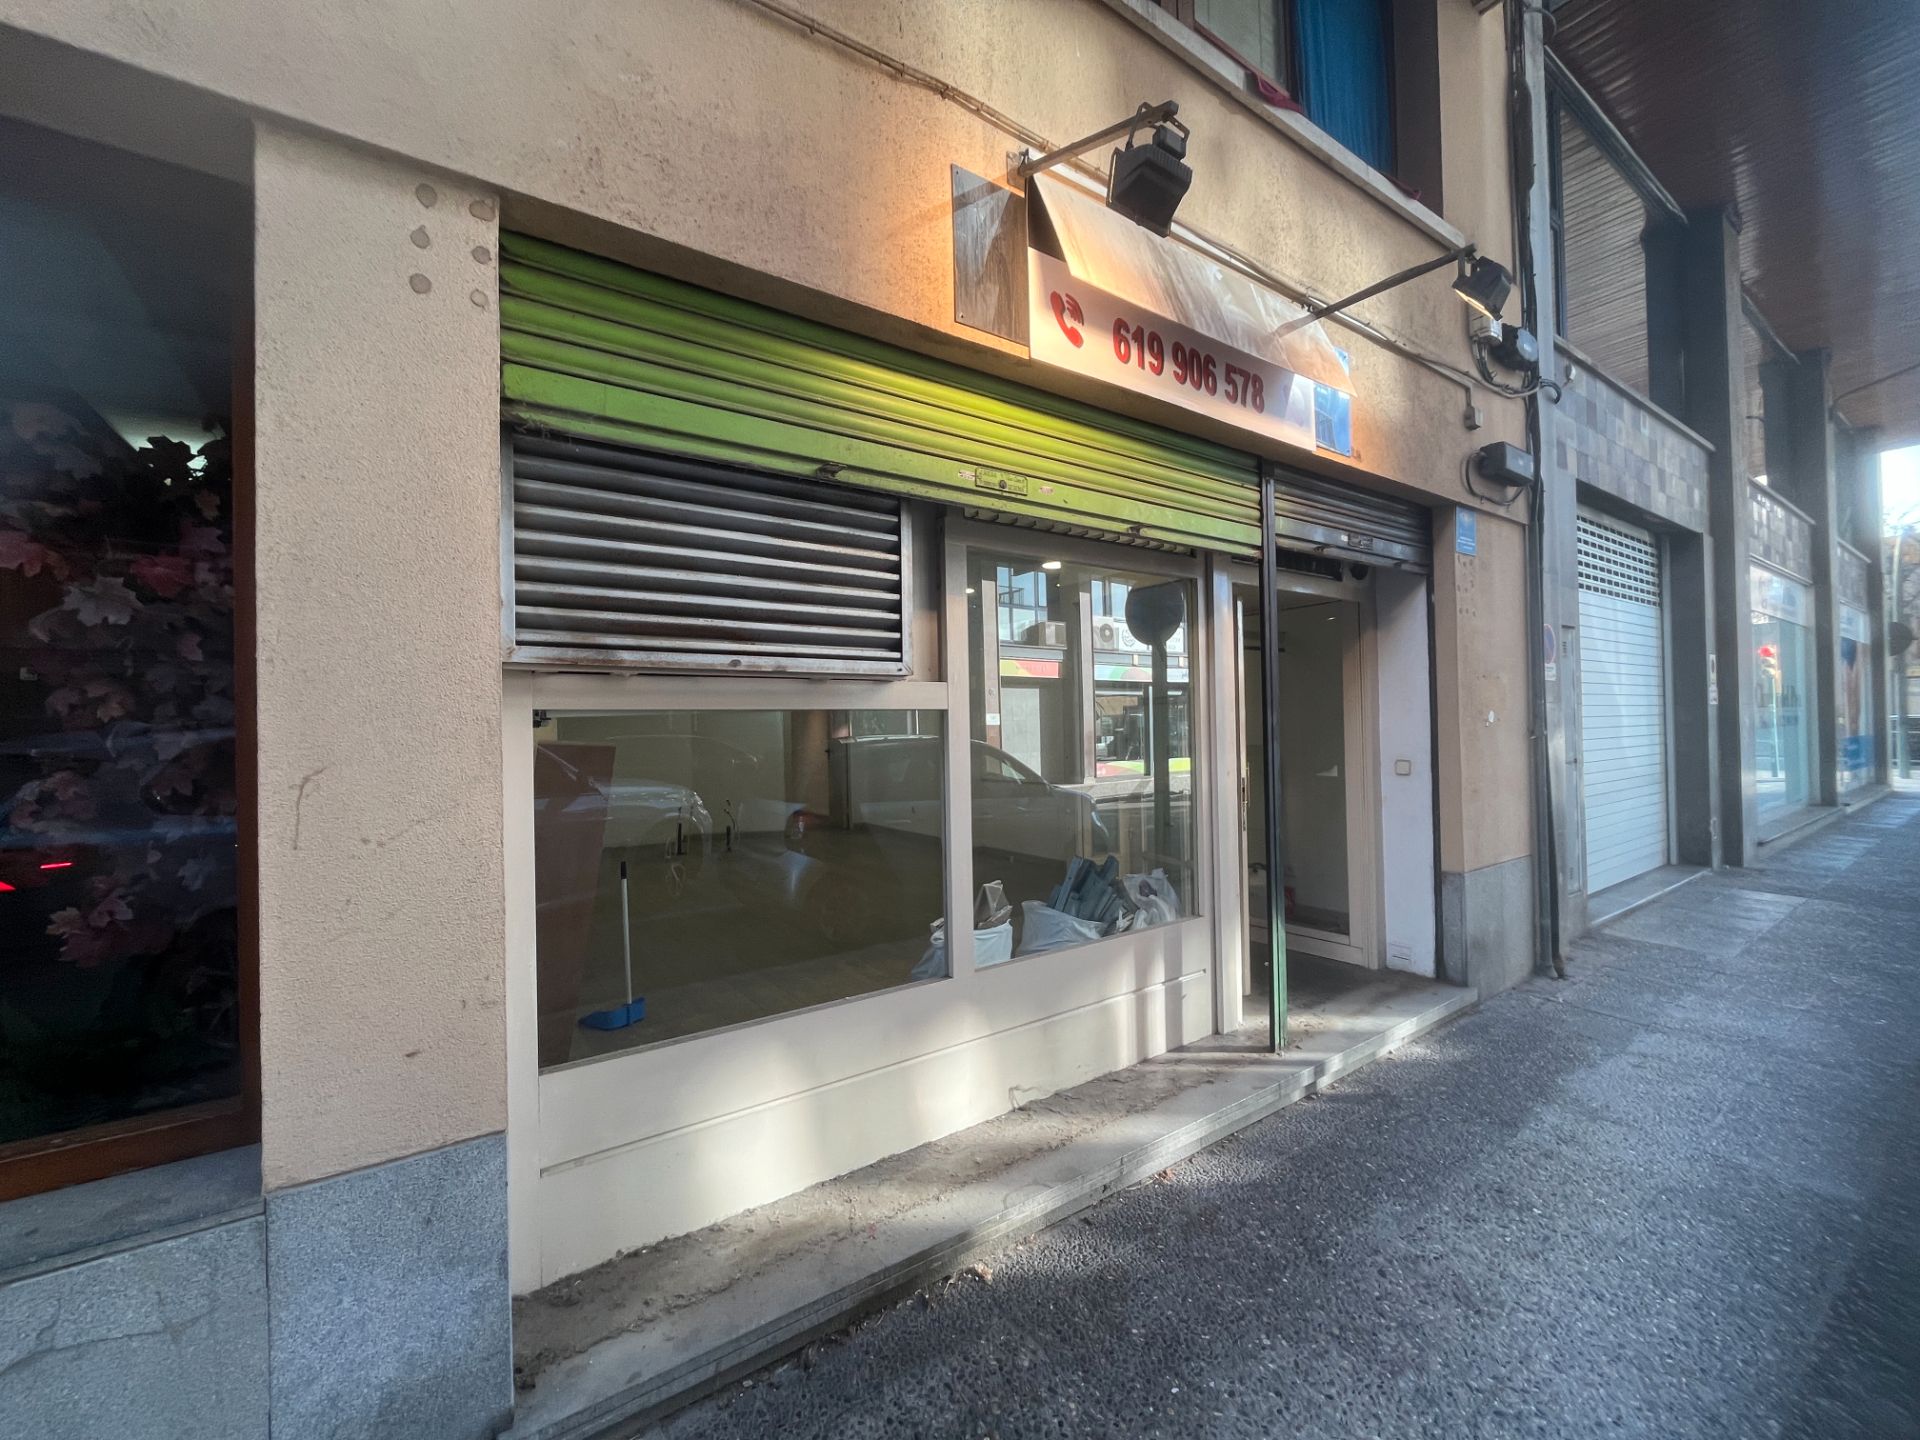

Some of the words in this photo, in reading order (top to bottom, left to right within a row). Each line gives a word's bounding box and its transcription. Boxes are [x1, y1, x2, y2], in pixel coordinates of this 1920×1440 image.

[1113, 318, 1164, 376] 619
[1172, 341, 1217, 396] 906
[1224, 362, 1264, 413] 578
